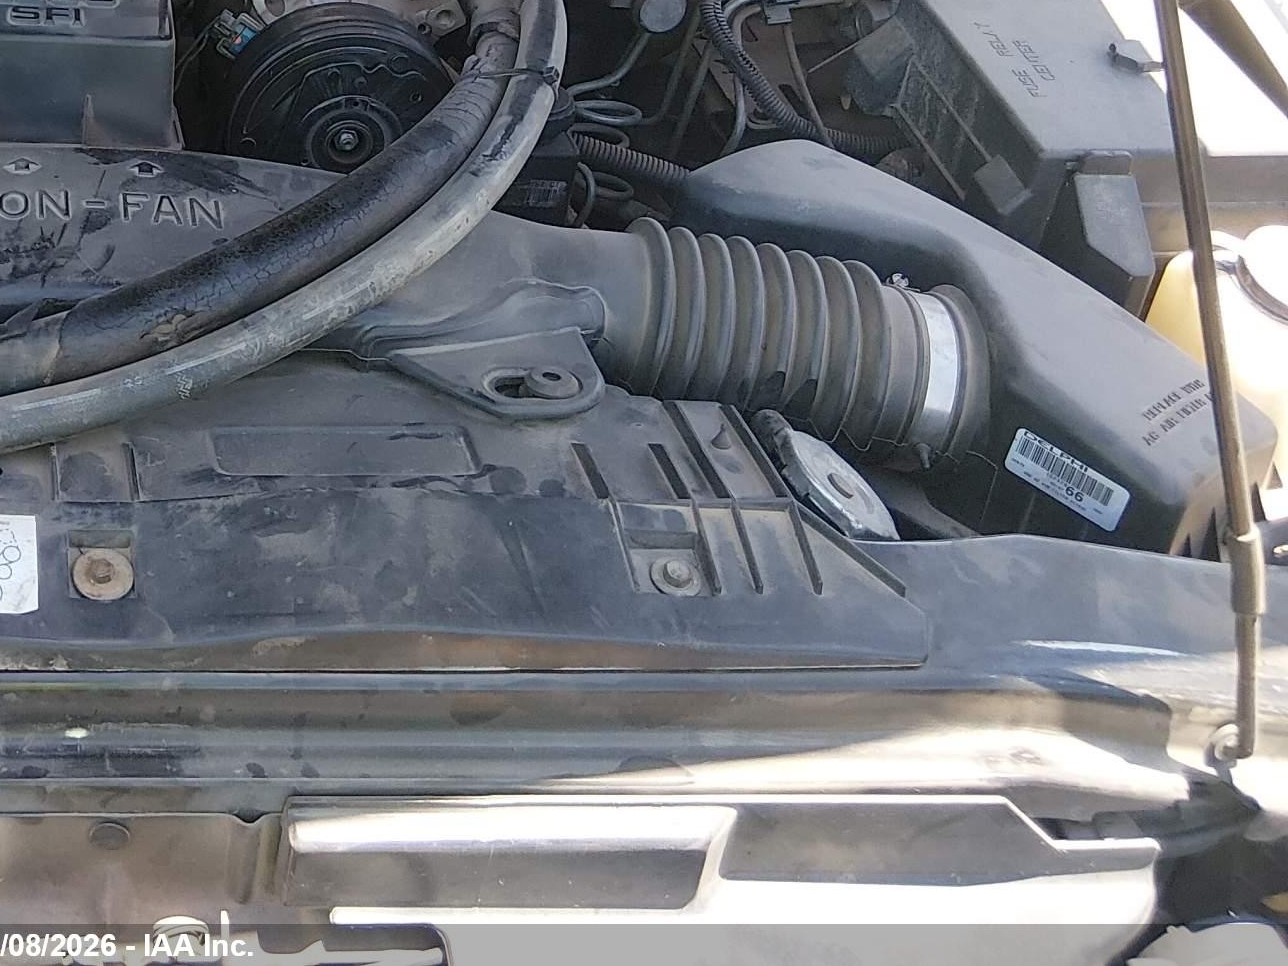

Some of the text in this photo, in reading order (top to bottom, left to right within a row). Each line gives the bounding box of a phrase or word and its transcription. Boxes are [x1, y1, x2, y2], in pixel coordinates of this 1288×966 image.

[10, 5, 84, 25] SFI
[119, 191, 226, 231] FAN
[1023, 430, 1089, 473] DELPHI
[1065, 486, 1085, 502] 66
